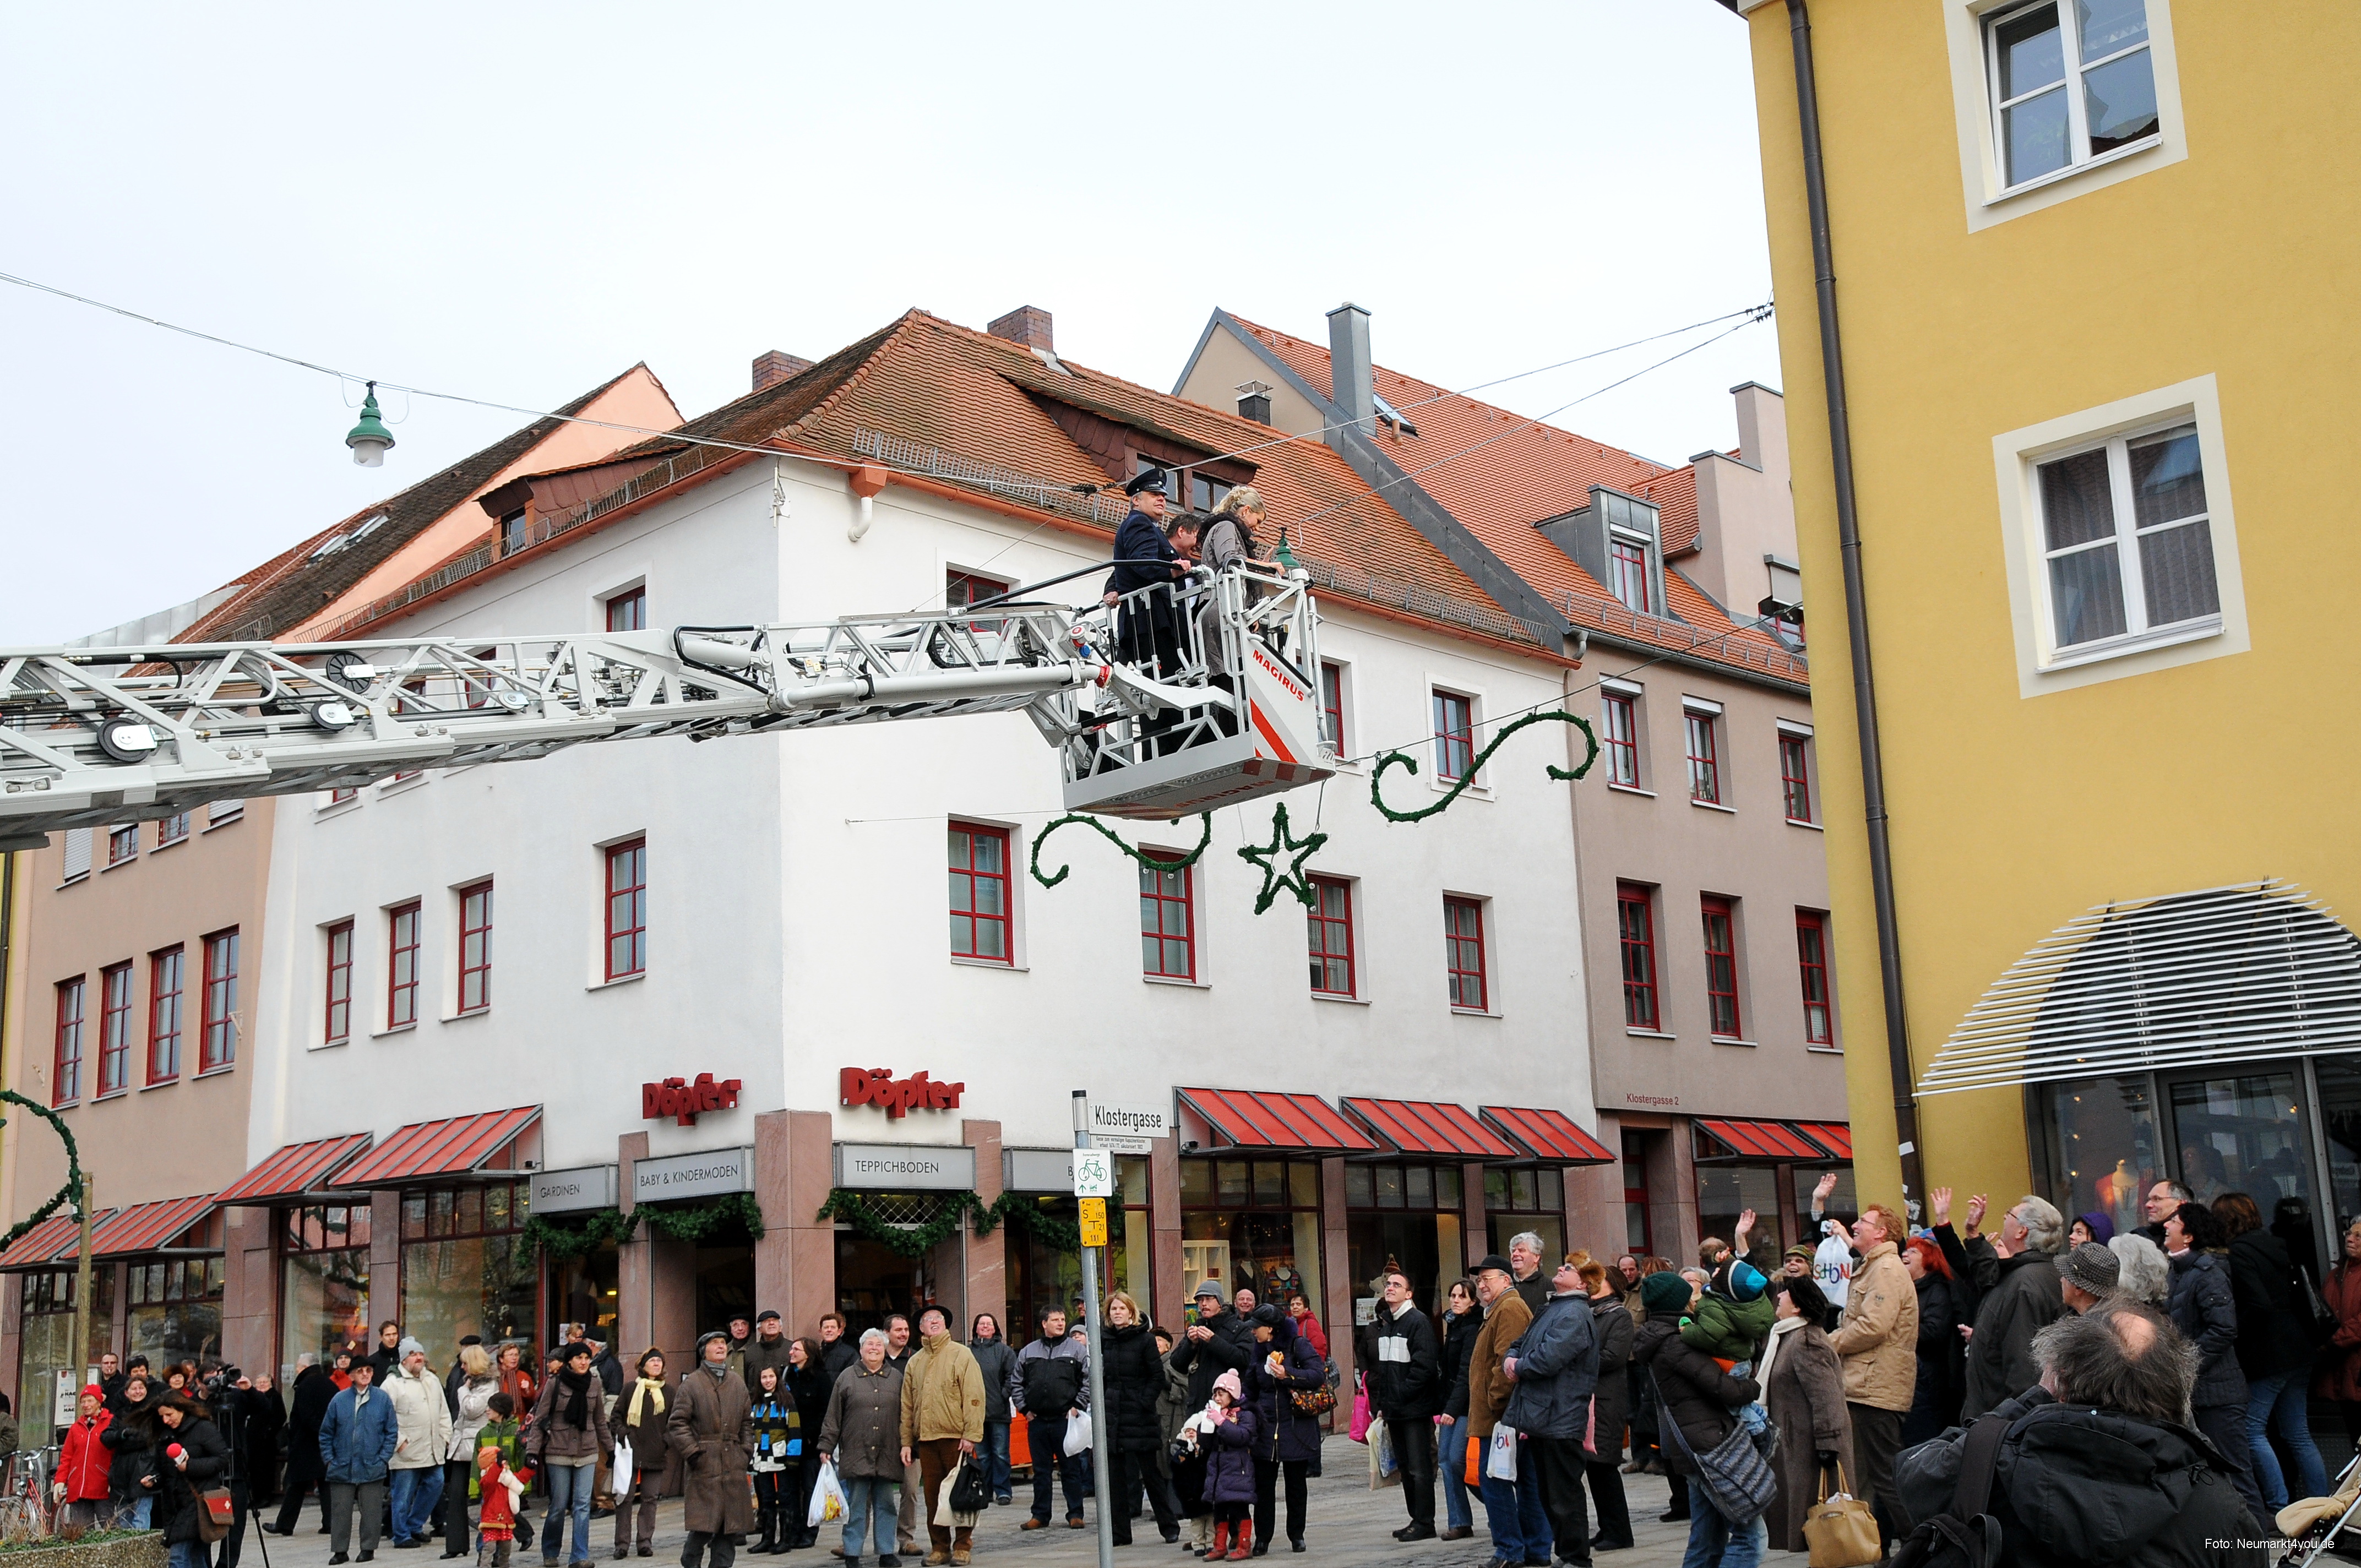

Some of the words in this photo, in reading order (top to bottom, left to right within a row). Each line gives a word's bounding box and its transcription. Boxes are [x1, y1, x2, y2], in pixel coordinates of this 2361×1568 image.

[1253, 649, 1304, 701] MAGIRUS
[642, 1072, 742, 1126] Döpfer
[840, 1067, 965, 1118] Döpfer
[1626, 1093, 1673, 1106] Klostergasse
[1674, 1096, 1679, 1106] 2
[1095, 1105, 1162, 1133] Klostergasse
[640, 1174, 661, 1186] BABY
[663, 1173, 670, 1184] &
[673, 1164, 738, 1183] KINDERMODEN
[855, 1160, 939, 1174] TEPPICHBODEN
[540, 1184, 580, 1199] GARDINEN
[1082, 1209, 1089, 1219] S
